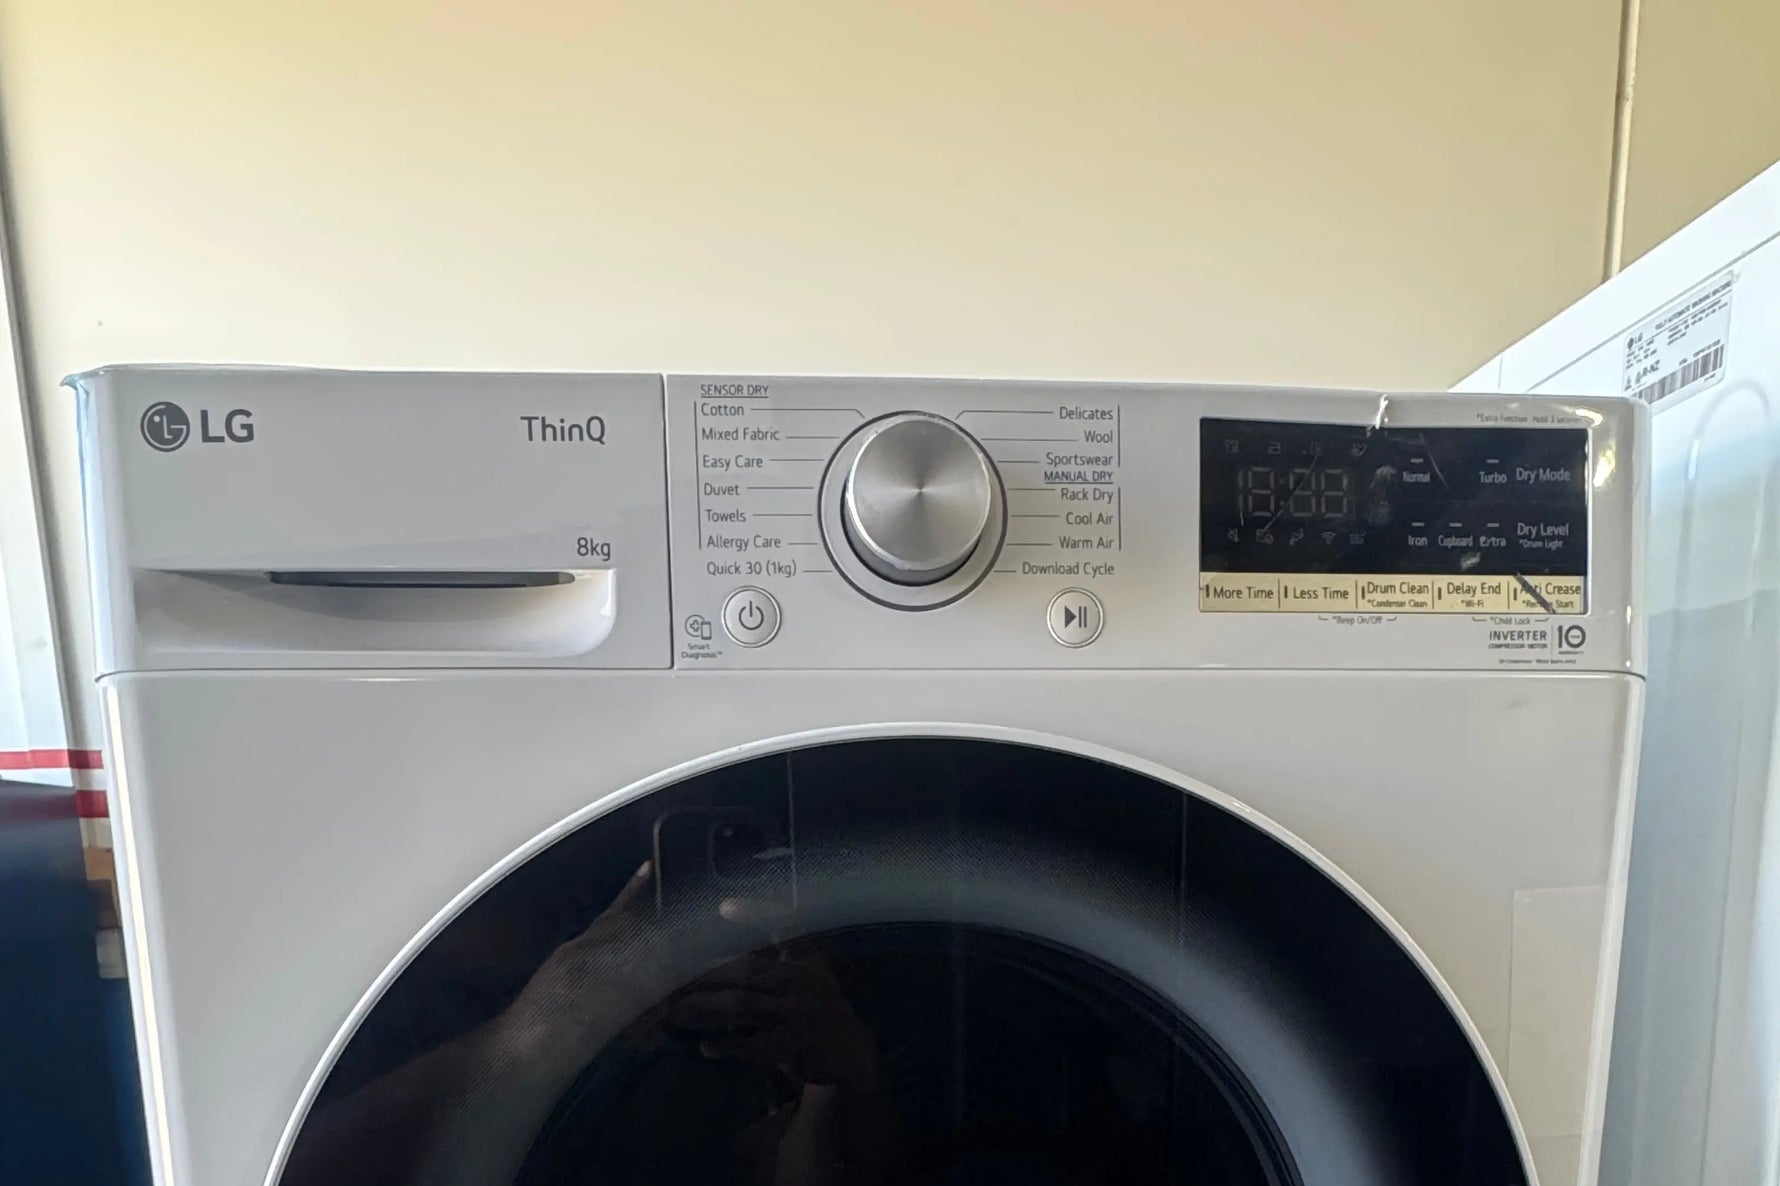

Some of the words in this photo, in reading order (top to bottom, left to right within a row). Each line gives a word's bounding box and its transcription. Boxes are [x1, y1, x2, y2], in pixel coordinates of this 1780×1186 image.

[700, 384, 744, 395] SENSOR
[746, 384, 769, 396] DRY
[700, 402, 745, 416] Cotton
[1059, 406, 1114, 420] Delicates
[200, 408, 254, 443] LG
[520, 415, 606, 446] ThinQ
[701, 427, 739, 440] Mixed
[743, 427, 780, 441] Fabric
[1084, 430, 1114, 443] Wool
[702, 455, 731, 471] Easy
[734, 455, 763, 468] Care
[1046, 452, 1114, 467] Sportswear
[1044, 471, 1089, 481] MANUAL
[1092, 471, 1114, 482] DRY
[1402, 471, 1431, 483] Normal
[1479, 471, 1507, 483] Turbo
[1516, 467, 1537, 484] Dry
[1539, 468, 1571, 482] Mode
[703, 482, 740, 496] Duvet
[1060, 488, 1089, 501] Rack
[1092, 488, 1114, 504] Dry
[705, 508, 746, 522] Towels
[1065, 512, 1092, 525] Cool
[1096, 512, 1114, 525] Air
[1517, 523, 1537, 539] Dry
[1540, 523, 1569, 537] Level
[707, 535, 750, 552] Allergy
[753, 535, 782, 549] Care
[1059, 536, 1093, 549] Warm
[1096, 536, 1114, 549] Air
[1408, 535, 1428, 546] Iron
[1438, 535, 1474, 549] Cupboard
[1545, 539, 1563, 551] Light
[575, 537, 611, 561] 8kg
[706, 561, 741, 576] Quick
[746, 561, 762, 575] 30
[766, 558, 798, 578] (1kg)
[1022, 561, 1080, 575] Download
[1083, 562, 1115, 578] Cycle
[1213, 586, 1243, 599] More
[1246, 586, 1274, 599] Time
[1293, 586, 1319, 599] Less
[1322, 586, 1349, 599] Time
[1367, 581, 1397, 595] Drum
[1399, 581, 1429, 595] Clean
[1446, 582, 1477, 598] Delay
[1481, 582, 1501, 595] End
[1545, 582, 1582, 595] Crease
[1408, 599, 1428, 608] Clean
[1555, 600, 1574, 608] Start
[1356, 616, 1382, 625] On/Off
[1514, 617, 1531, 625] Lock
[1489, 630, 1547, 641] INVERTER
[1557, 624, 1586, 649] 10
